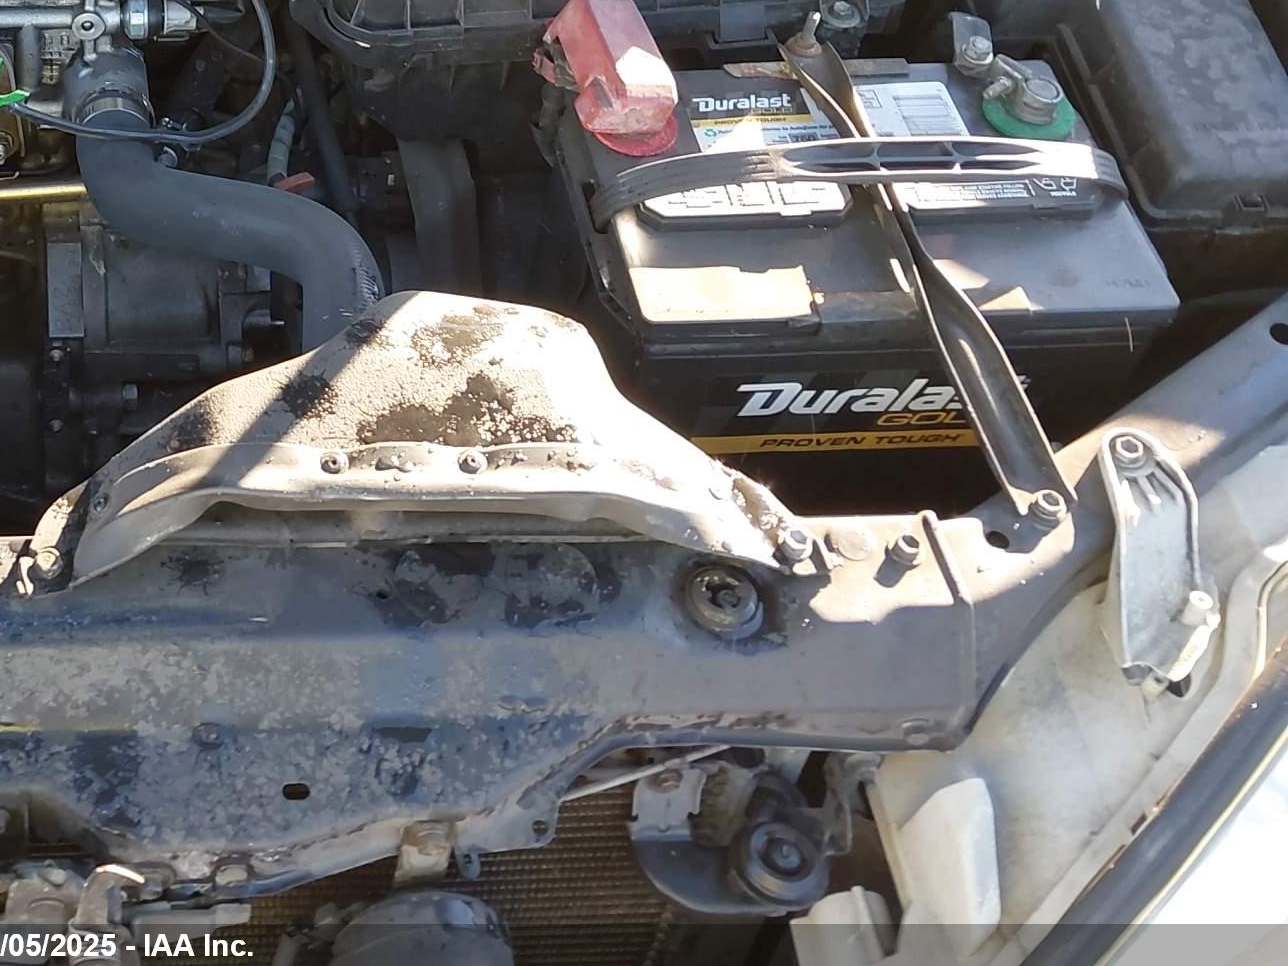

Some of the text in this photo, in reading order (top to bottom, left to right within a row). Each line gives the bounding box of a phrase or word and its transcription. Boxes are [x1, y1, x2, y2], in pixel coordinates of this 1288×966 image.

[692, 93, 792, 113] Duralast
[736, 376, 1032, 416] Durala
[876, 411, 967, 426] GOL
[760, 433, 962, 448] PROVEN TOUGH
